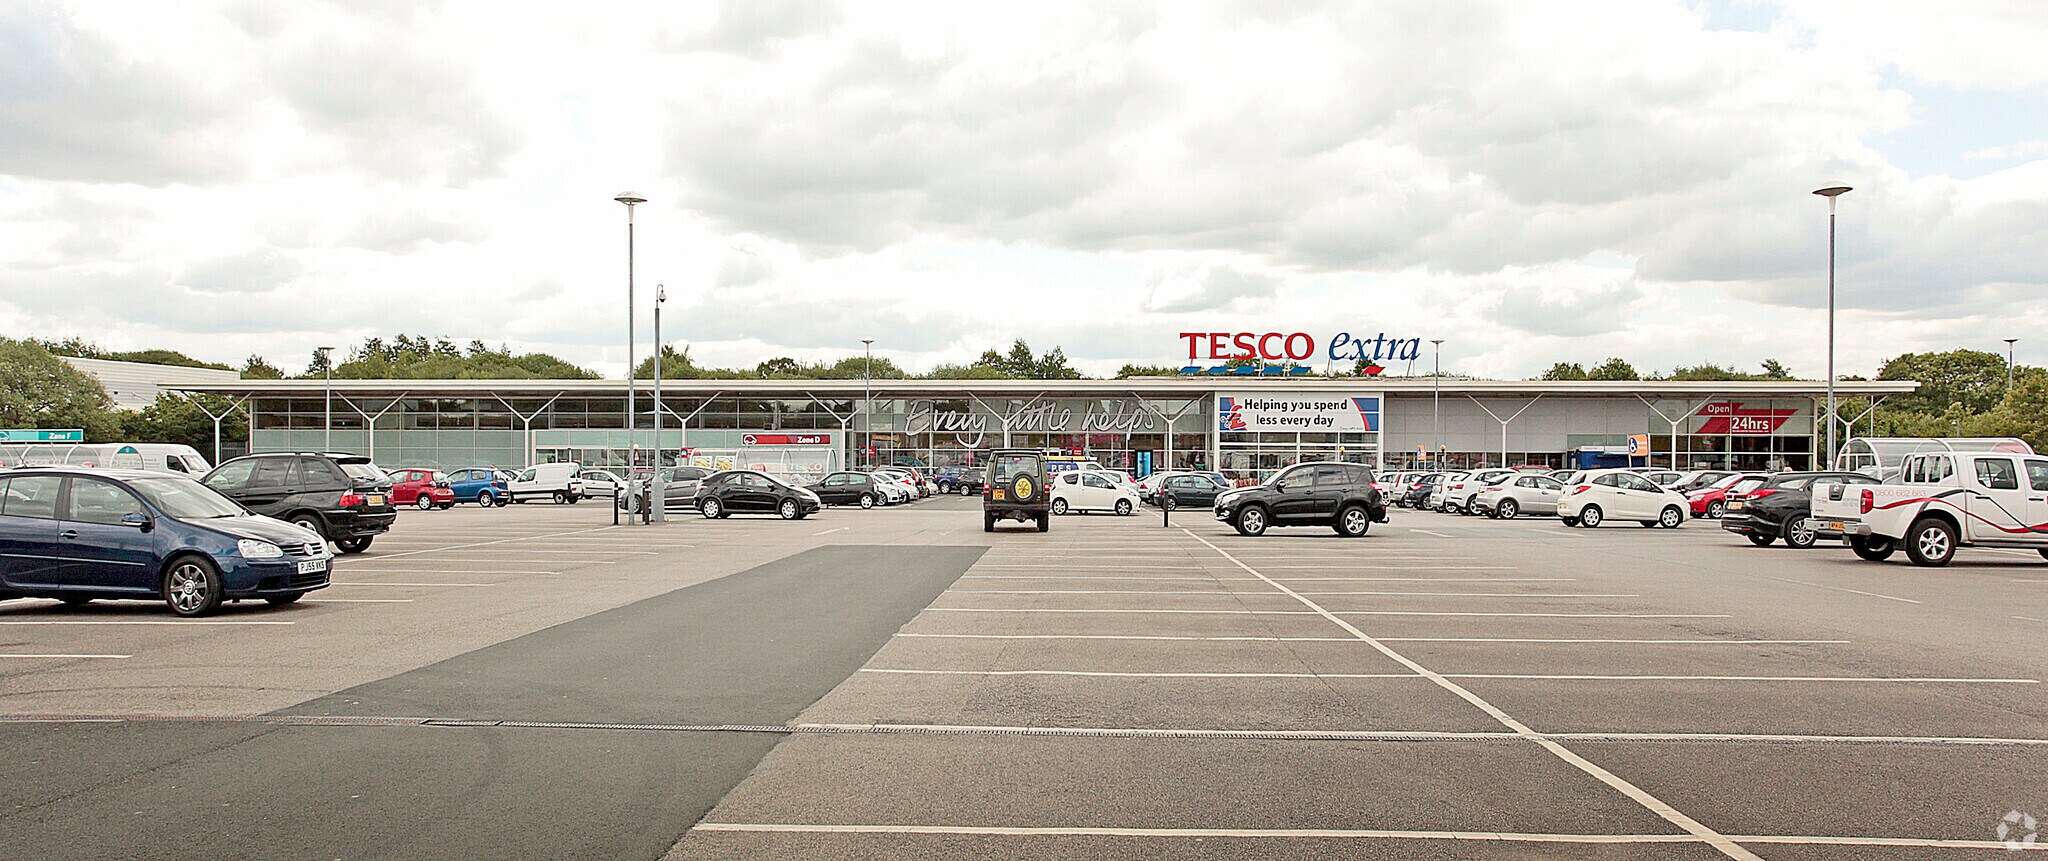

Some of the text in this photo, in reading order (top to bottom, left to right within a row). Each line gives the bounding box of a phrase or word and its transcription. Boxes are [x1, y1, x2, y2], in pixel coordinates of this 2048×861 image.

[1179, 332, 1421, 361] TESCO extra
[1244, 399, 1347, 412] Helping you spend
[1707, 404, 1730, 415] Open
[904, 399, 987, 448] Every
[1081, 400, 1158, 440] helps
[1256, 414, 1334, 428] less every day
[1732, 417, 1769, 429] 24hrs
[49, 432, 72, 440] Zone F
[797, 436, 821, 444] Zone D
